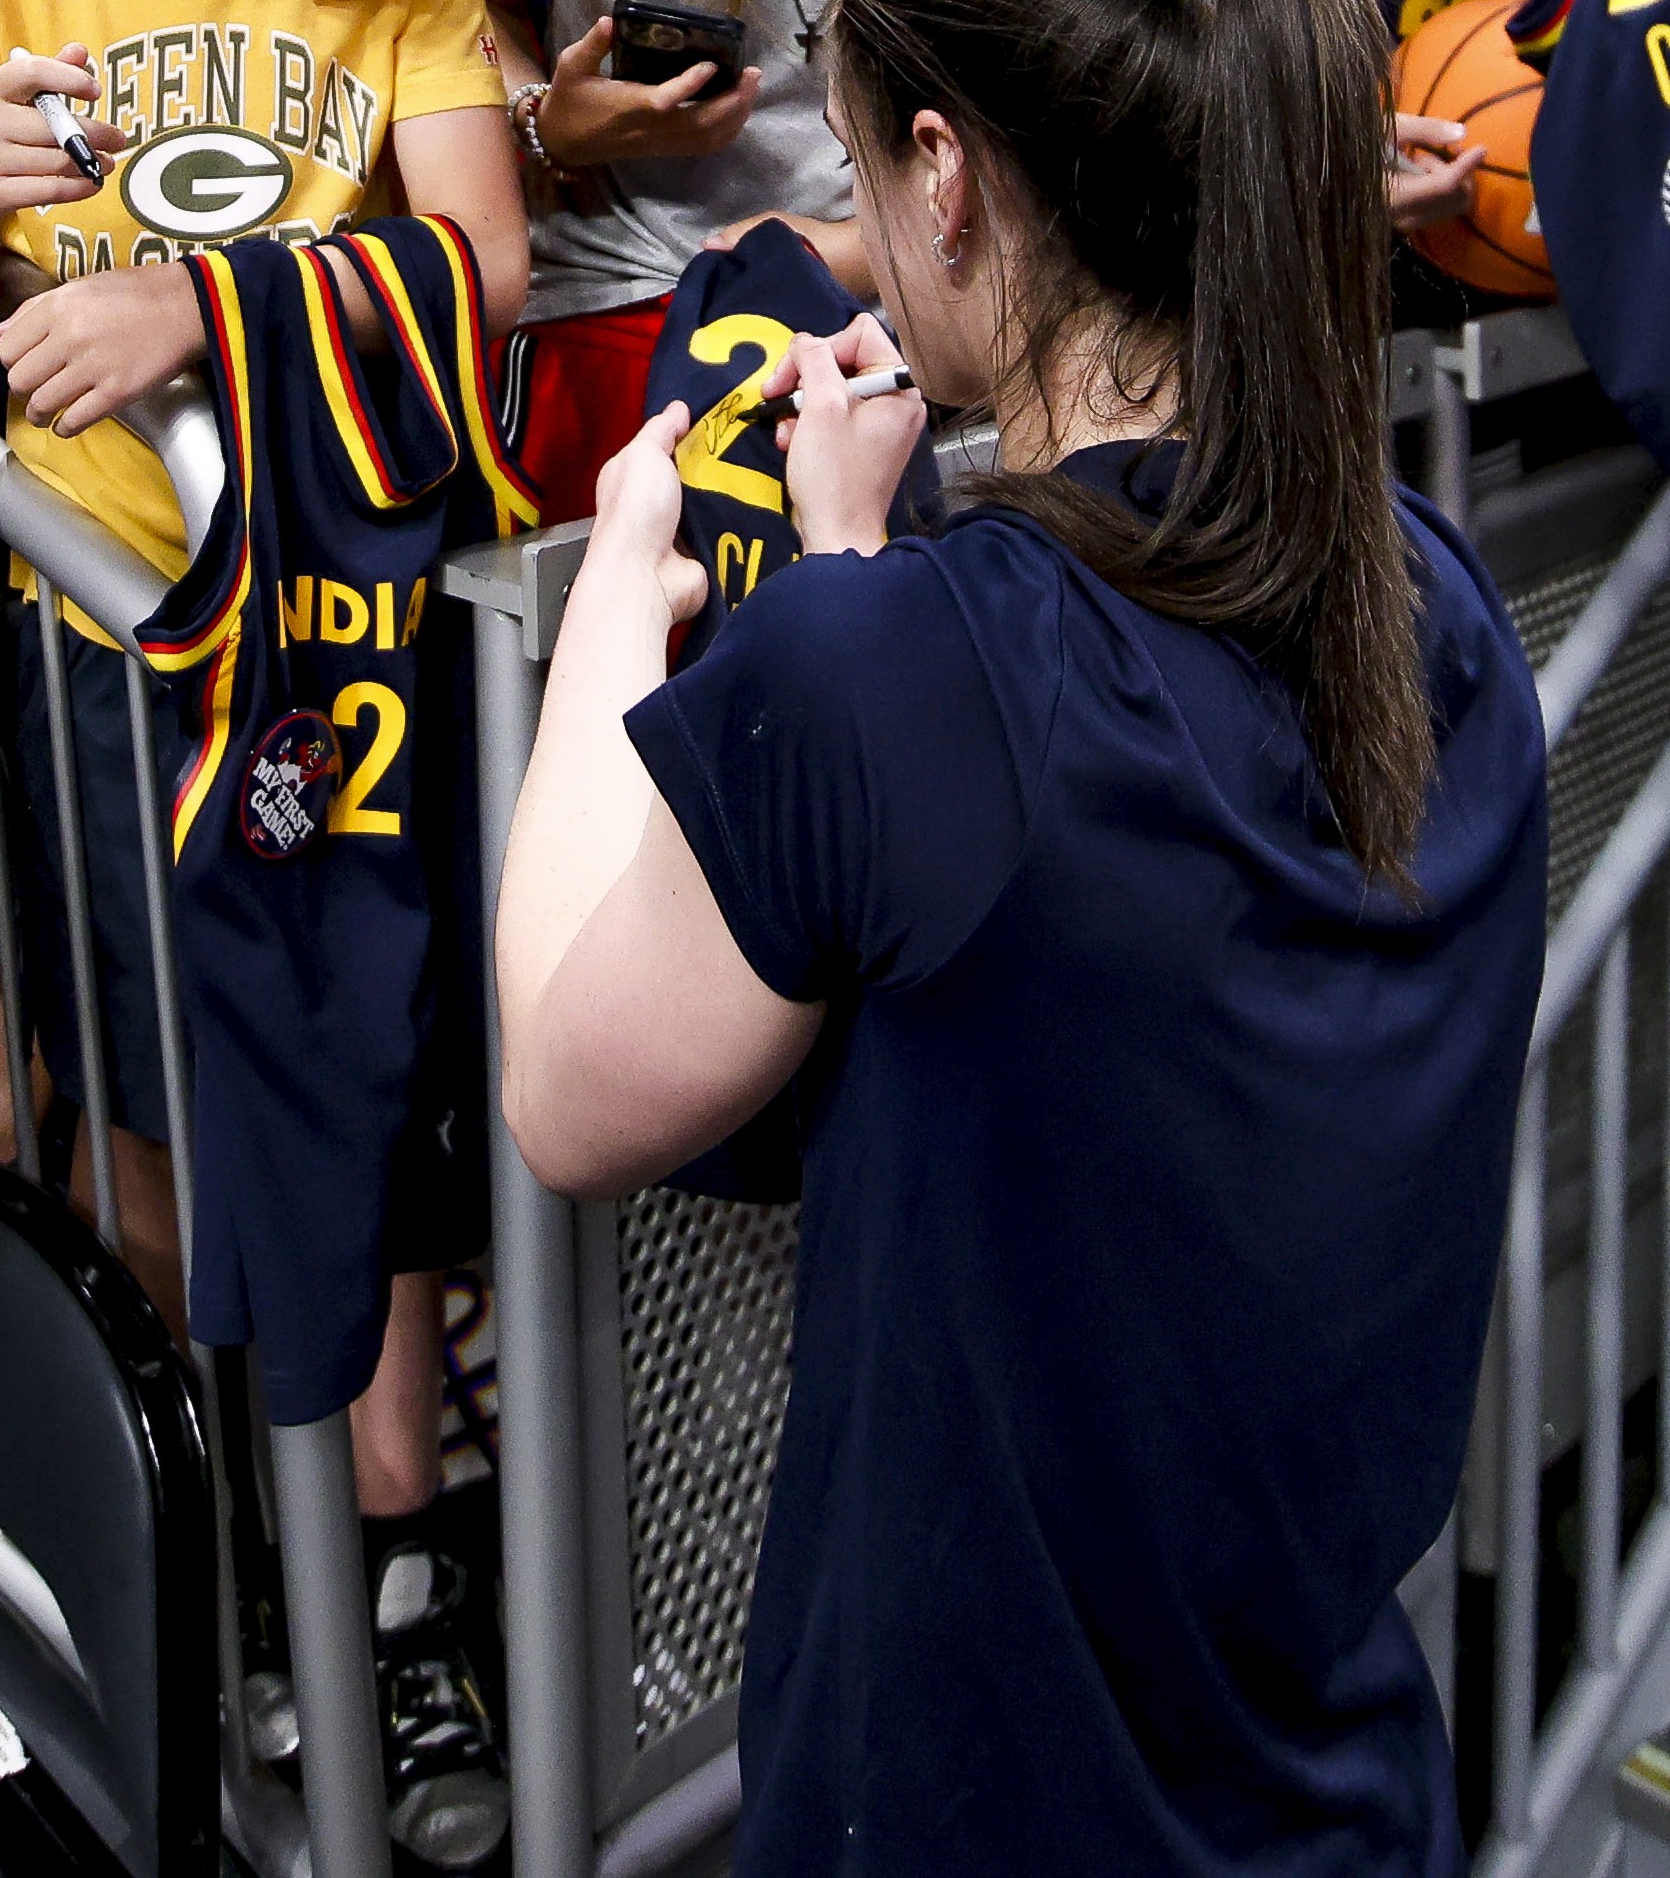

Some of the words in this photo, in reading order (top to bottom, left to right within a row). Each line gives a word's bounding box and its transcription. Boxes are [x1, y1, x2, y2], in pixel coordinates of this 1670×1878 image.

[270, 29, 379, 188] BAY
[277, 575, 427, 651] NDIA
[274, 784, 315, 839] FIRST
